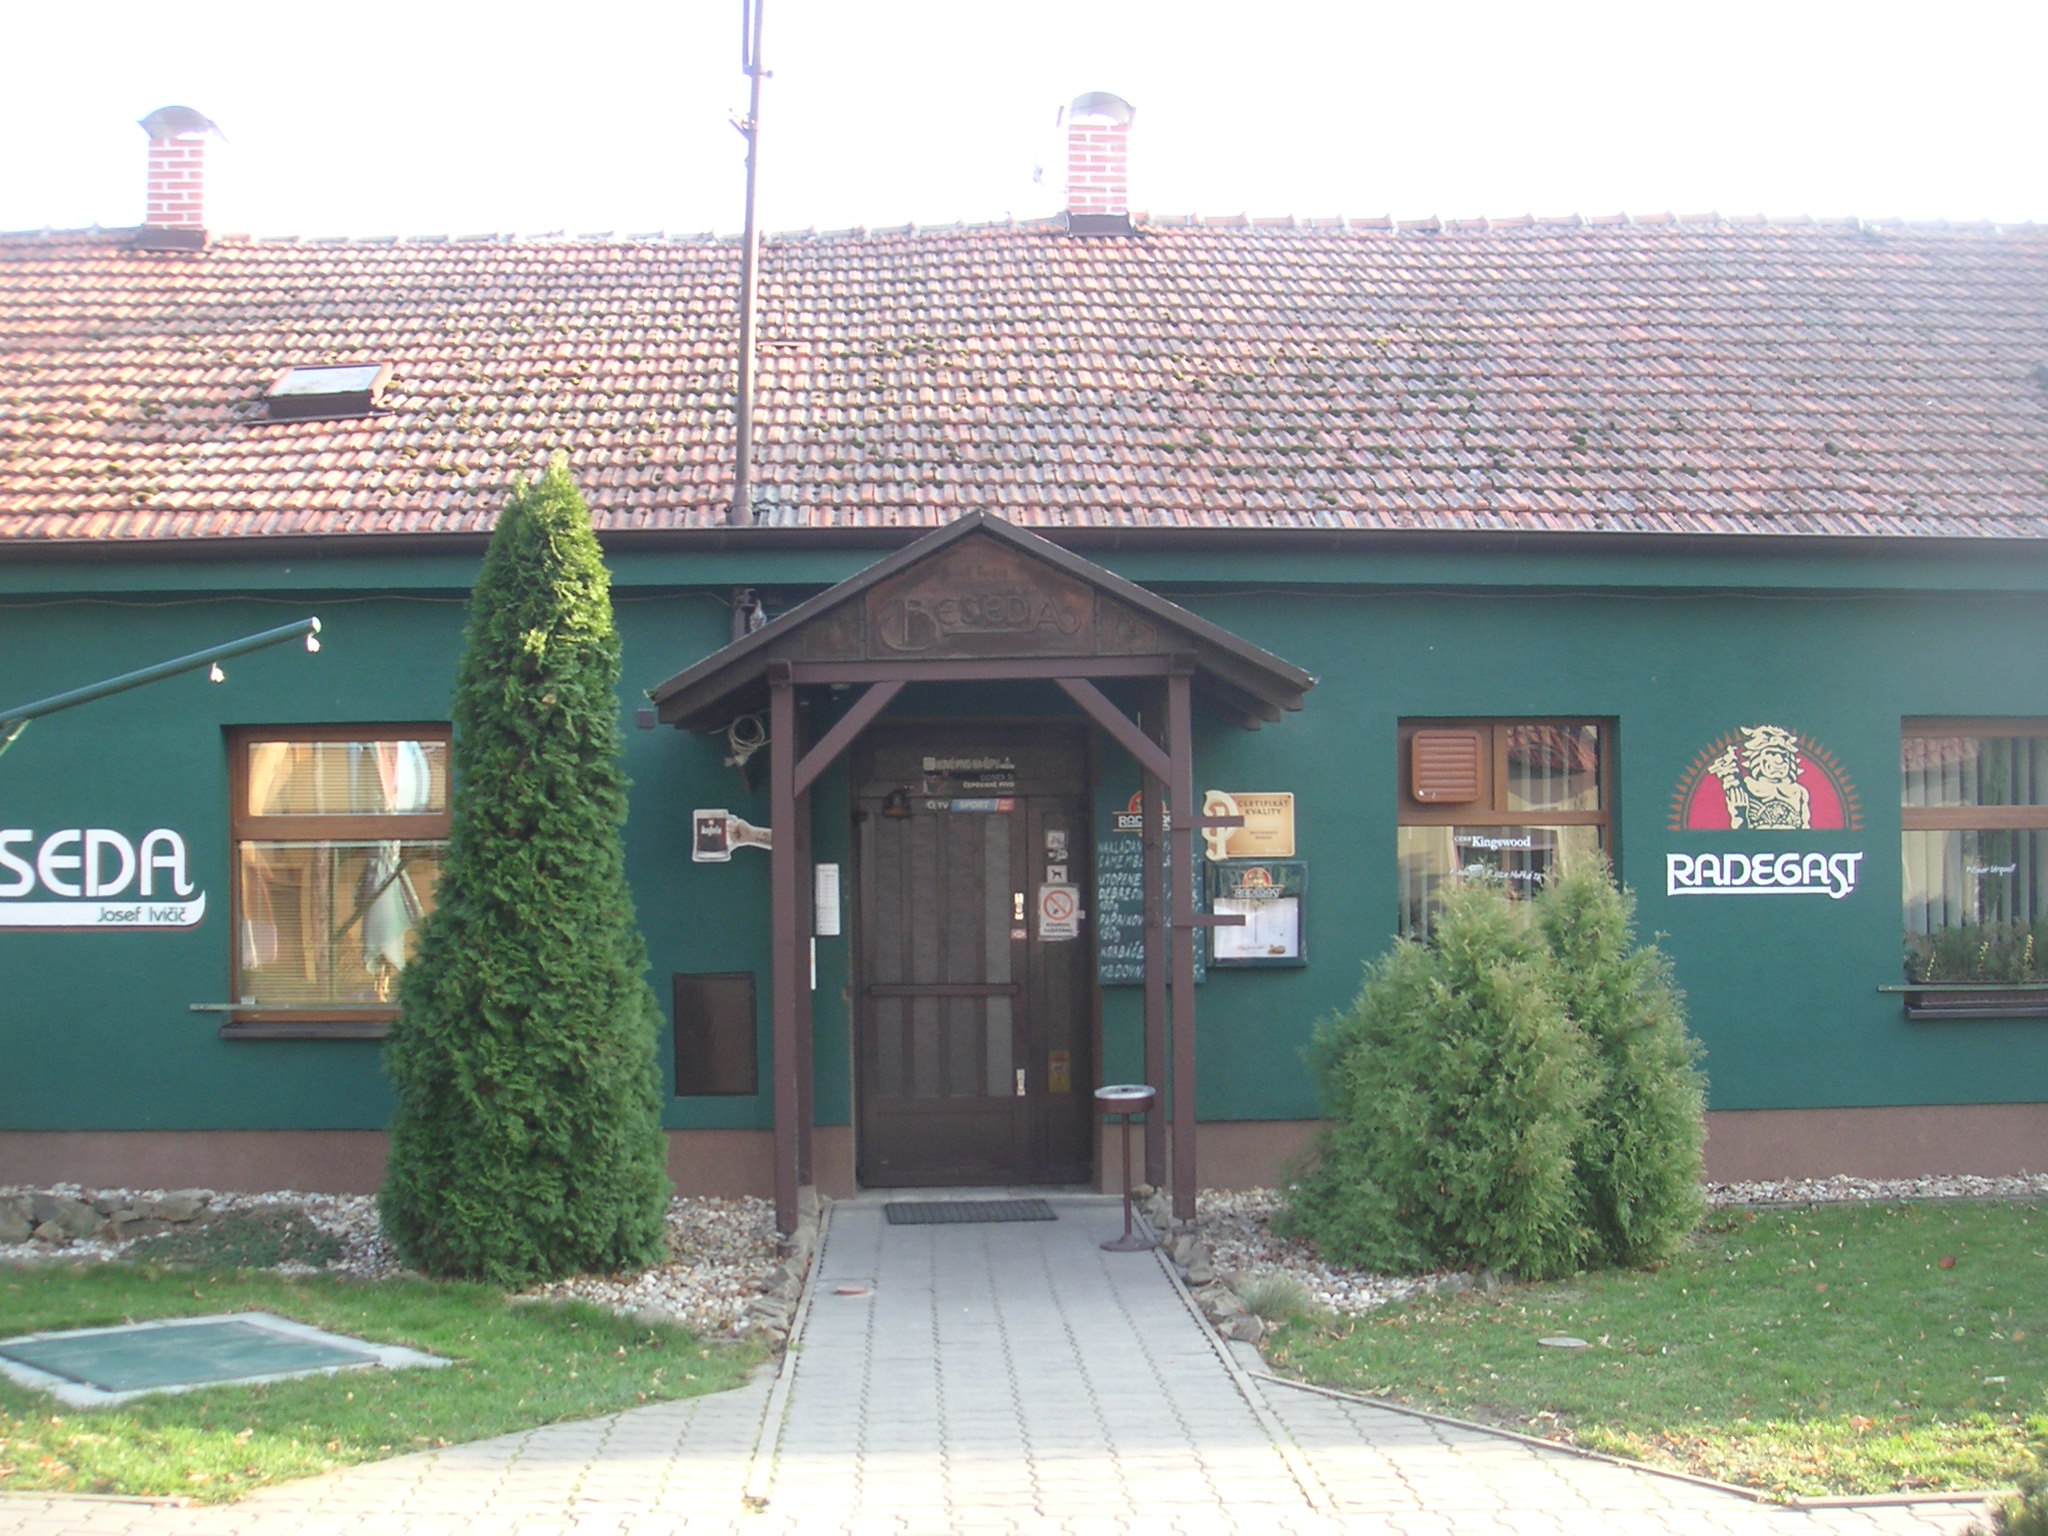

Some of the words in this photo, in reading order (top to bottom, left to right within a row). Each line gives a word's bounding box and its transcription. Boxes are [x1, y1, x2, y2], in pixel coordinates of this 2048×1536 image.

[1245, 808, 1281, 816] KVALITY
[1472, 836, 1531, 851] Kingswood
[1666, 852, 1863, 899] RADEGAST
[98, 907, 141, 922] Josef
[149, 907, 186, 922] Ivičič
